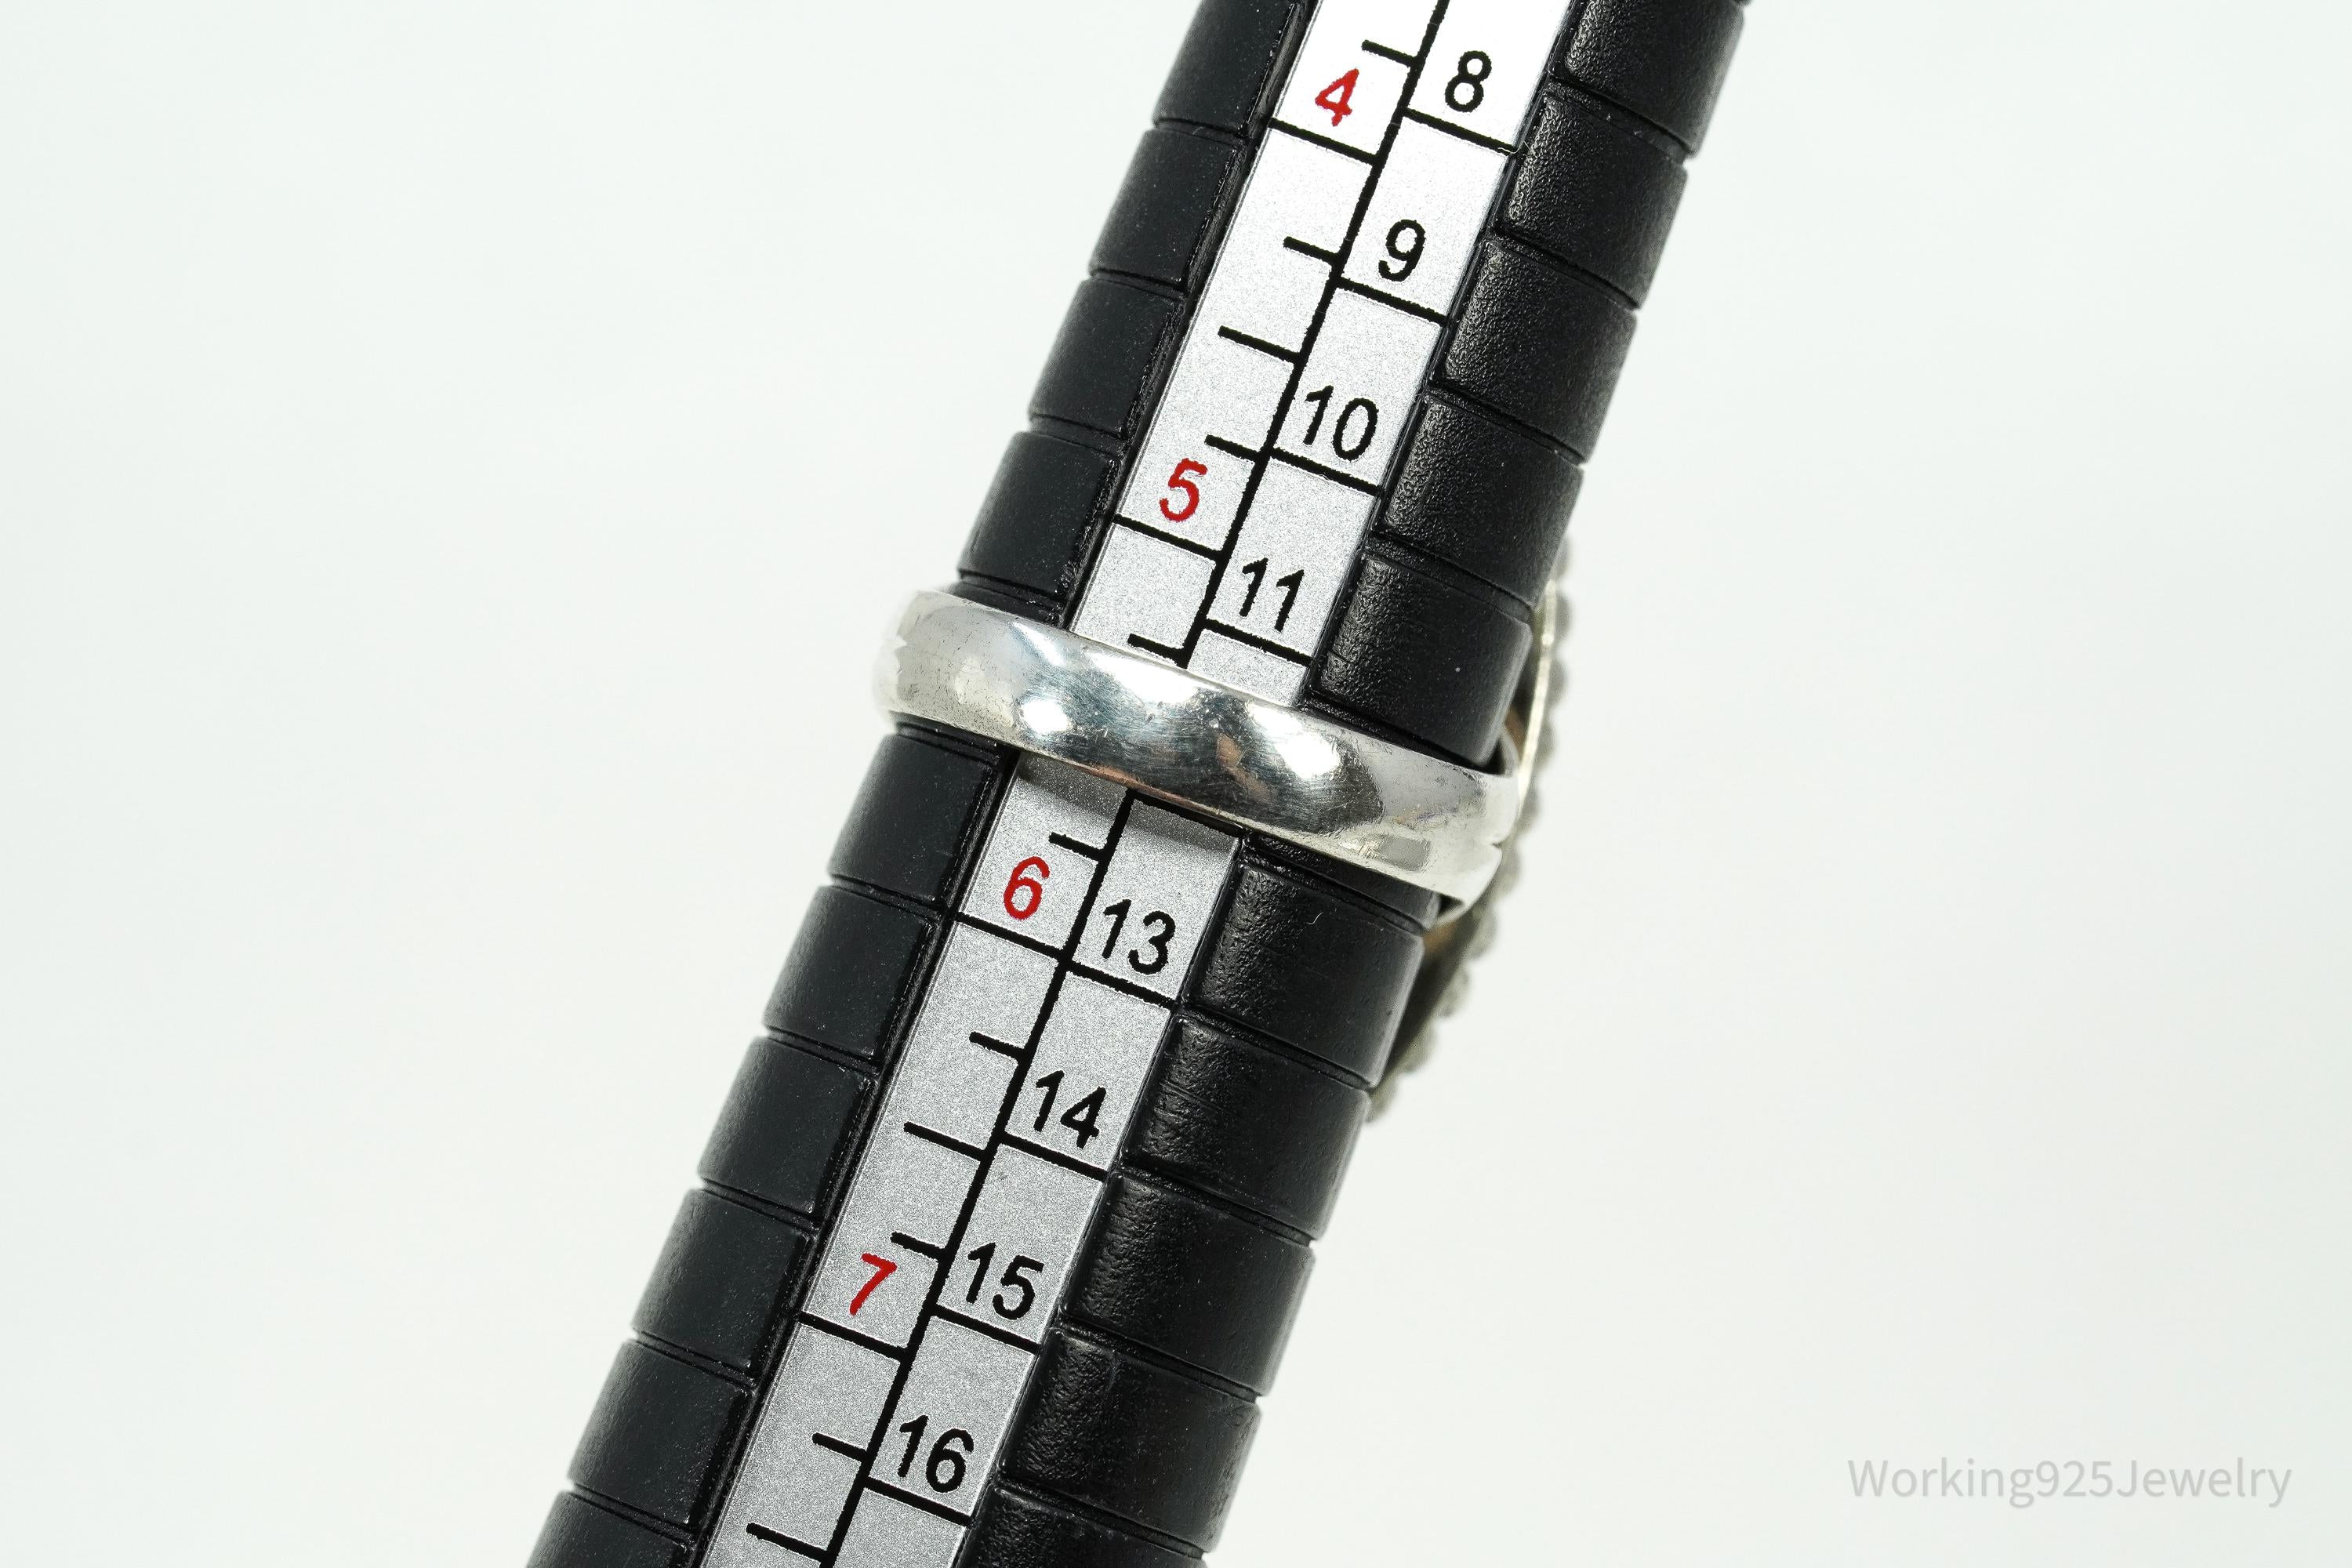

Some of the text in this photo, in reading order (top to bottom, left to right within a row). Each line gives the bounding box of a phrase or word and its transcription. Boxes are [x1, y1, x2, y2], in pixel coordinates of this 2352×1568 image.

[1314, 67, 1360, 127] 4
[1444, 49, 1492, 113] 8
[1378, 219, 1427, 282] 9
[1302, 384, 1379, 463] 10
[1159, 457, 1208, 524] 5
[1239, 557, 1305, 633] 11
[1002, 855, 1051, 922] 6
[1102, 898, 1176, 975] 13
[1033, 1070, 1107, 1150] 14
[848, 1251, 898, 1317] 7
[965, 1242, 1045, 1321] 15
[897, 1414, 975, 1494] 16
